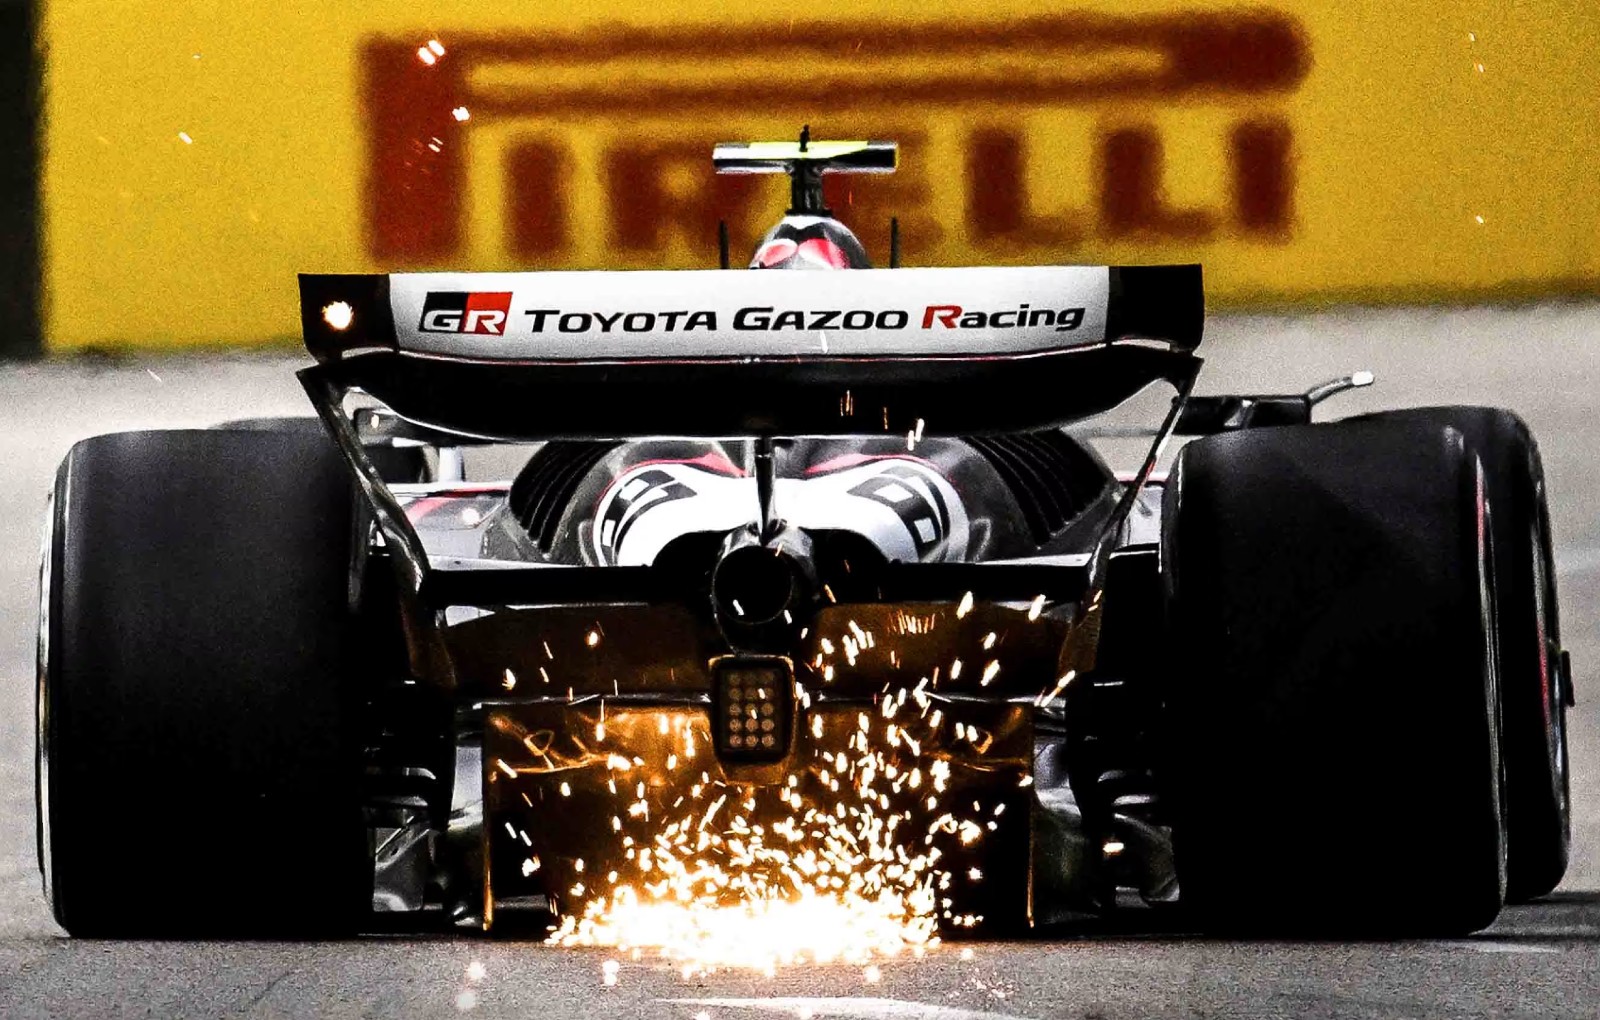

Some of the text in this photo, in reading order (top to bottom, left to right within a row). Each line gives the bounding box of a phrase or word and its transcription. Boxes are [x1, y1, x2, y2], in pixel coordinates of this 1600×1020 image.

[358, 10, 1312, 268] PIRELLI
[421, 307, 508, 335] GR
[525, 304, 1086, 333] TOYOTA GAZOO Racing
